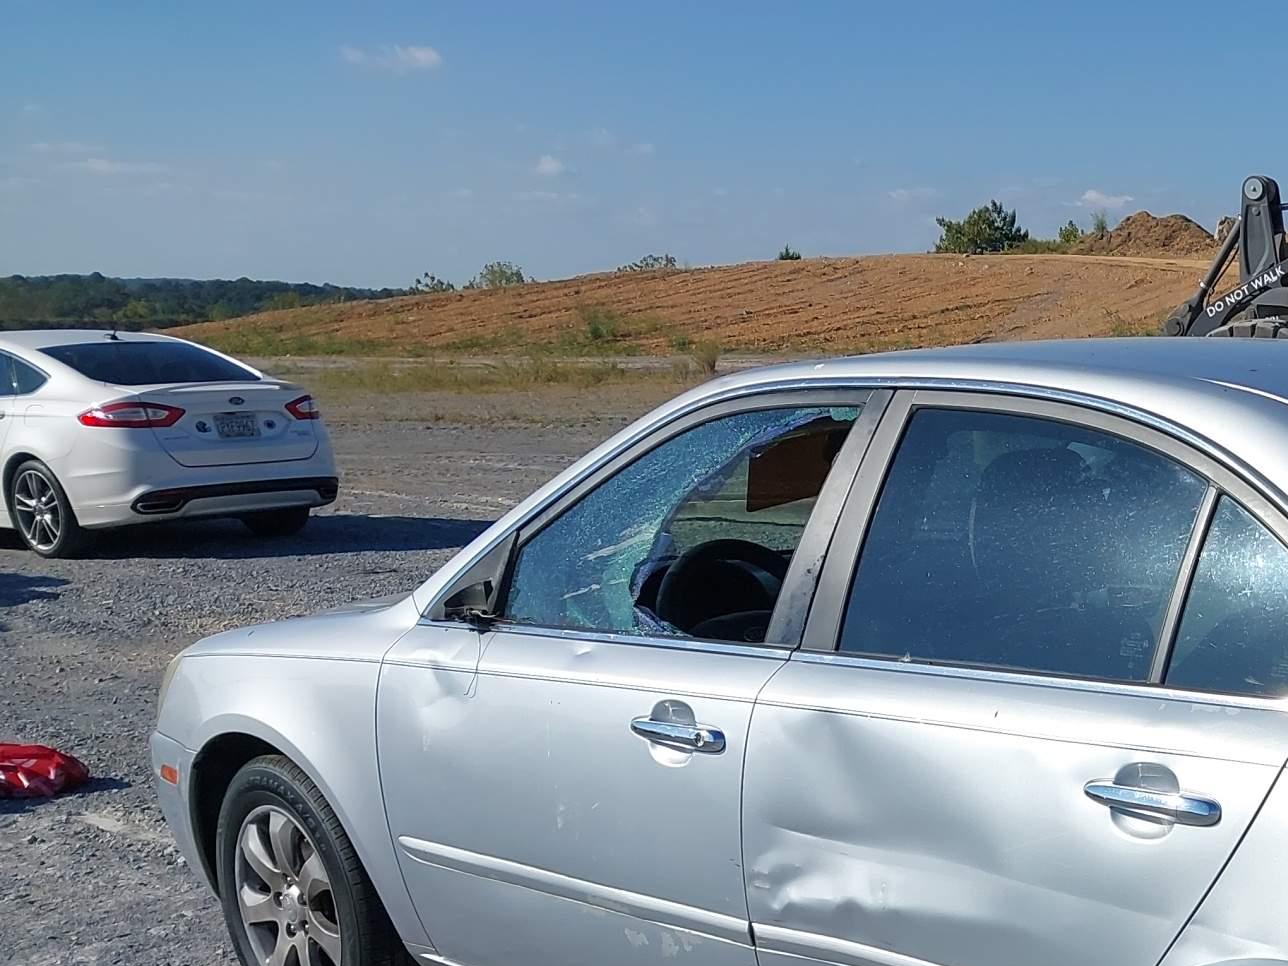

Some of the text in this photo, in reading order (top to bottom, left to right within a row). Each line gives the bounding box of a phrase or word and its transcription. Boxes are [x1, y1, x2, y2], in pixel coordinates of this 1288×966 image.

[1206, 265, 1285, 317] DO NOT WALK
